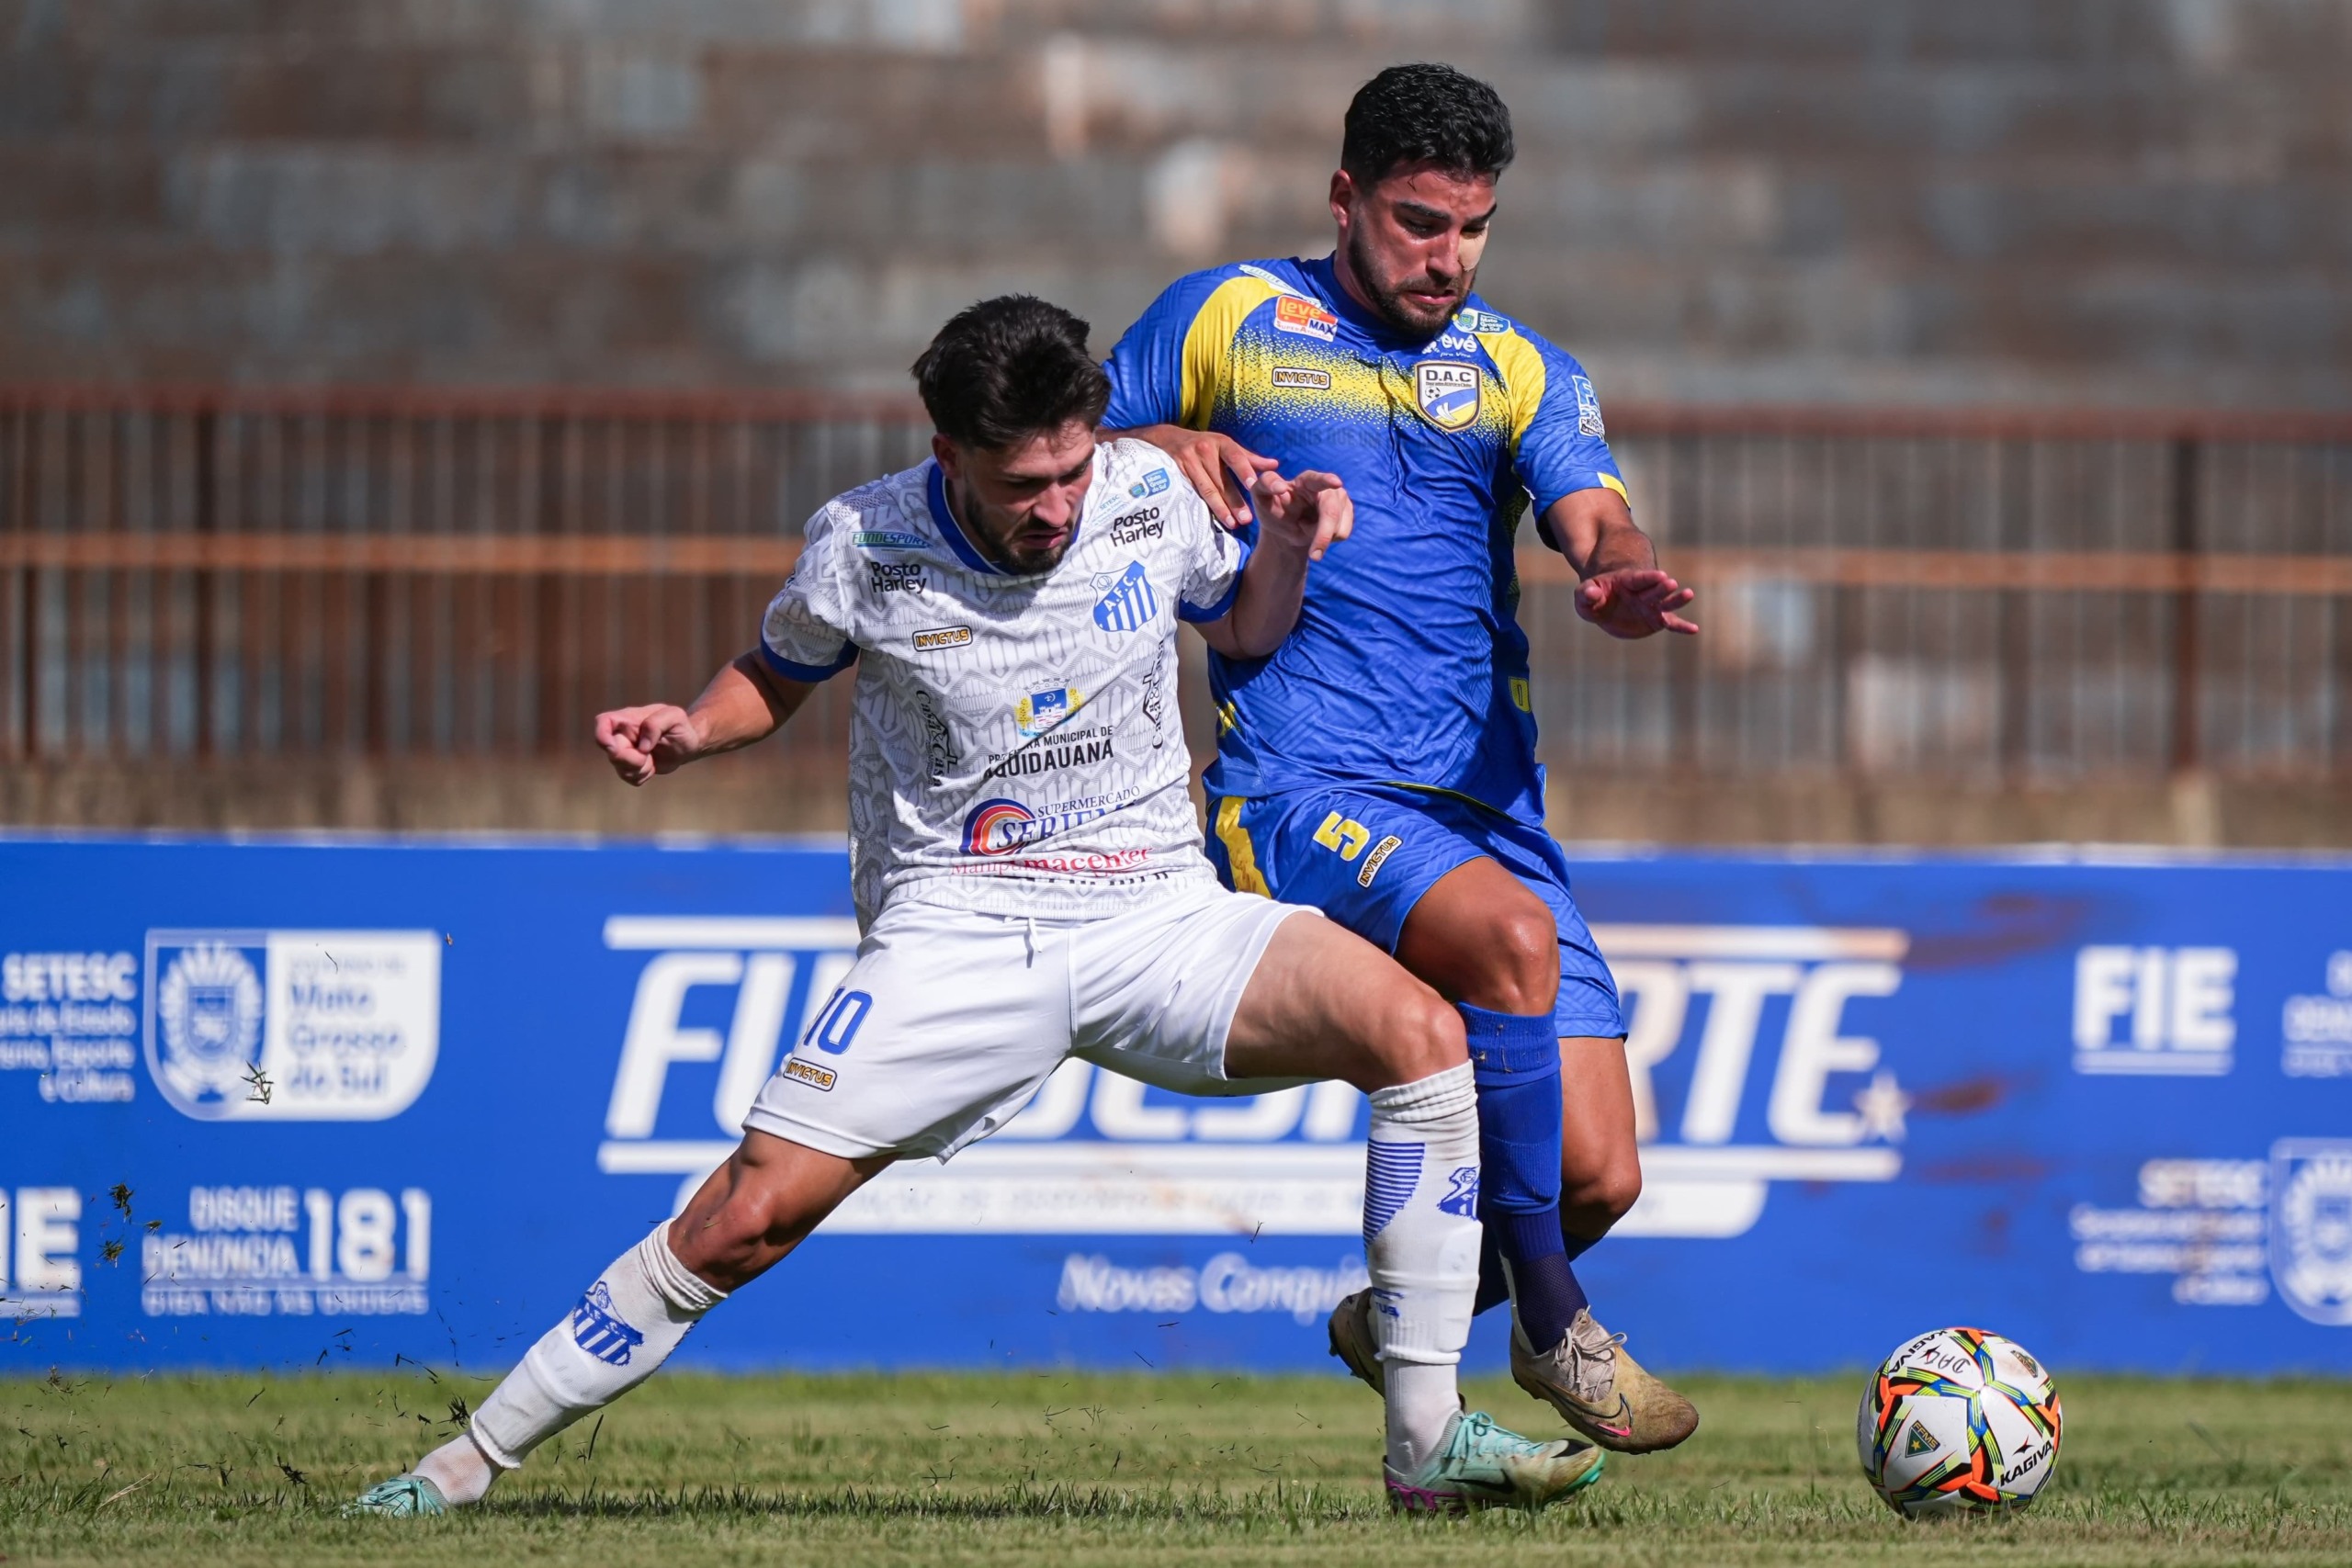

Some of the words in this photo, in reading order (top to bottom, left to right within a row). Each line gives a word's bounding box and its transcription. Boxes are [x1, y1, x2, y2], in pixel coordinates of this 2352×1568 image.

[1280, 297, 1321, 320] Leve
[1308, 319, 1338, 336] MAX
[1274, 370, 1328, 385] INVICTUS
[1110, 520, 1165, 547] Harley
[1114, 506, 1159, 531] Posto
[870, 561, 922, 577] Posto
[870, 576, 928, 594] Harley
[915, 628, 969, 648] INVICTUS
[1043, 728, 1098, 747] MUNICIPAL
[1101, 725, 1114, 737] DE
[1037, 785, 1141, 818] SUPERMERCADO
[1312, 810, 1371, 862] 5
[1360, 836, 1398, 886] INVICTUS
[2074, 945, 2238, 1052] FIE
[802, 986, 874, 1055] 10
[786, 1061, 834, 1089] INVICTUS
[189, 1187, 300, 1231] DISQUE
[305, 1188, 431, 1282] 181
[1889, 1328, 1949, 1374] KAGIVA
[1911, 1419, 1941, 1451] FFMS
[1998, 1438, 2054, 1488] KAGIVA
